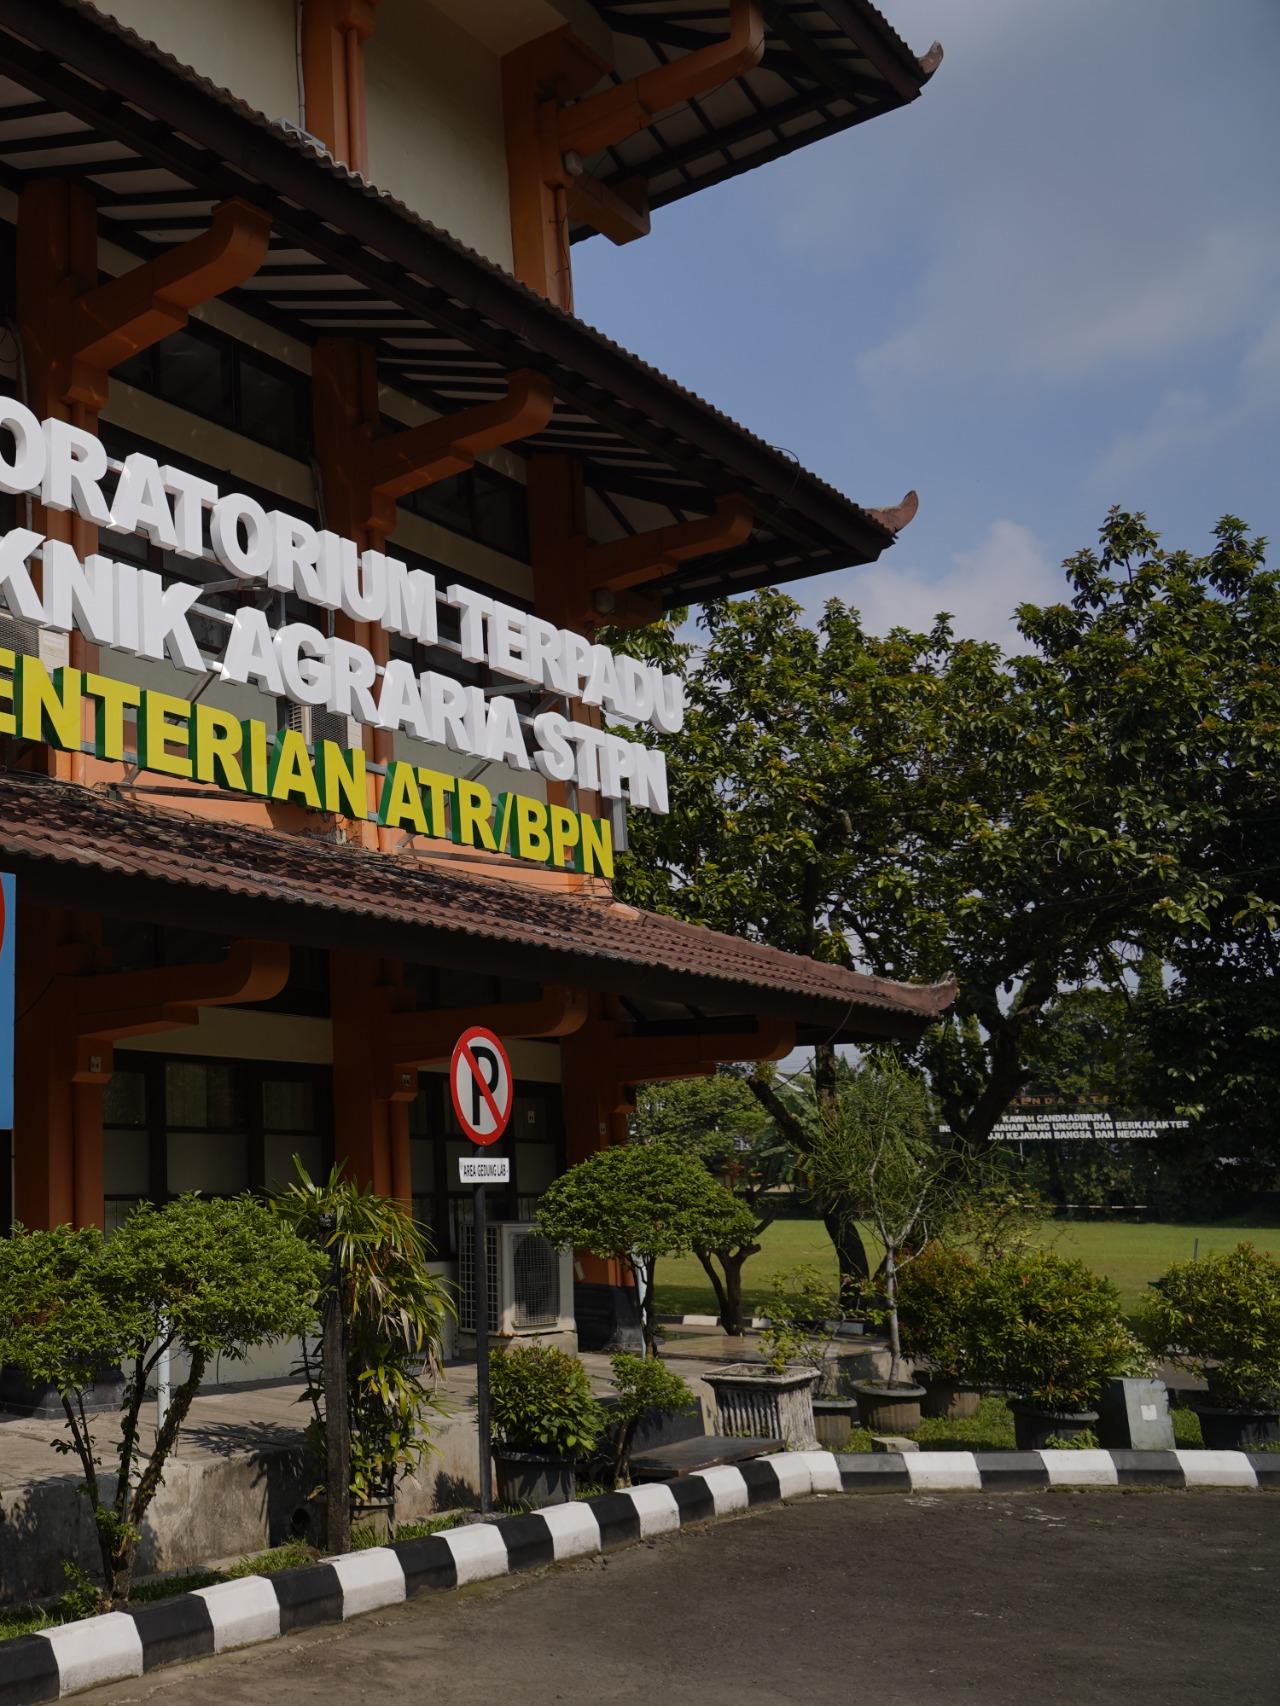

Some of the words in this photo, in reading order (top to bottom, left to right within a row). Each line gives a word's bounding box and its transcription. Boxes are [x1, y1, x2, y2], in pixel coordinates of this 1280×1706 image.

[447, 584, 684, 734] TERPADU
[220, 606, 530, 771] AGRARIA
[534, 711, 669, 816] STPN
[378, 760, 614, 879] ATR/BPN
[1002, 1115, 1035, 1123] KAWAH
[1036, 1113, 1111, 1122] CANDRADIMUKA
[1026, 1123, 1050, 1131] YANG
[1052, 1122, 1092, 1131] UNGGUL
[1093, 1121, 1113, 1130] DAN
[1006, 1131, 1052, 1140] KEJAYAAN
[1054, 1130, 1092, 1140] BANGSA
[1095, 1130, 1115, 1139] DAN
[1117, 1129, 1158, 1139] NEGARA
[464, 1164, 476, 1177] AREA
[477, 1164, 497, 1177] GEDUNG
[497, 1164, 506, 1177] LAB
